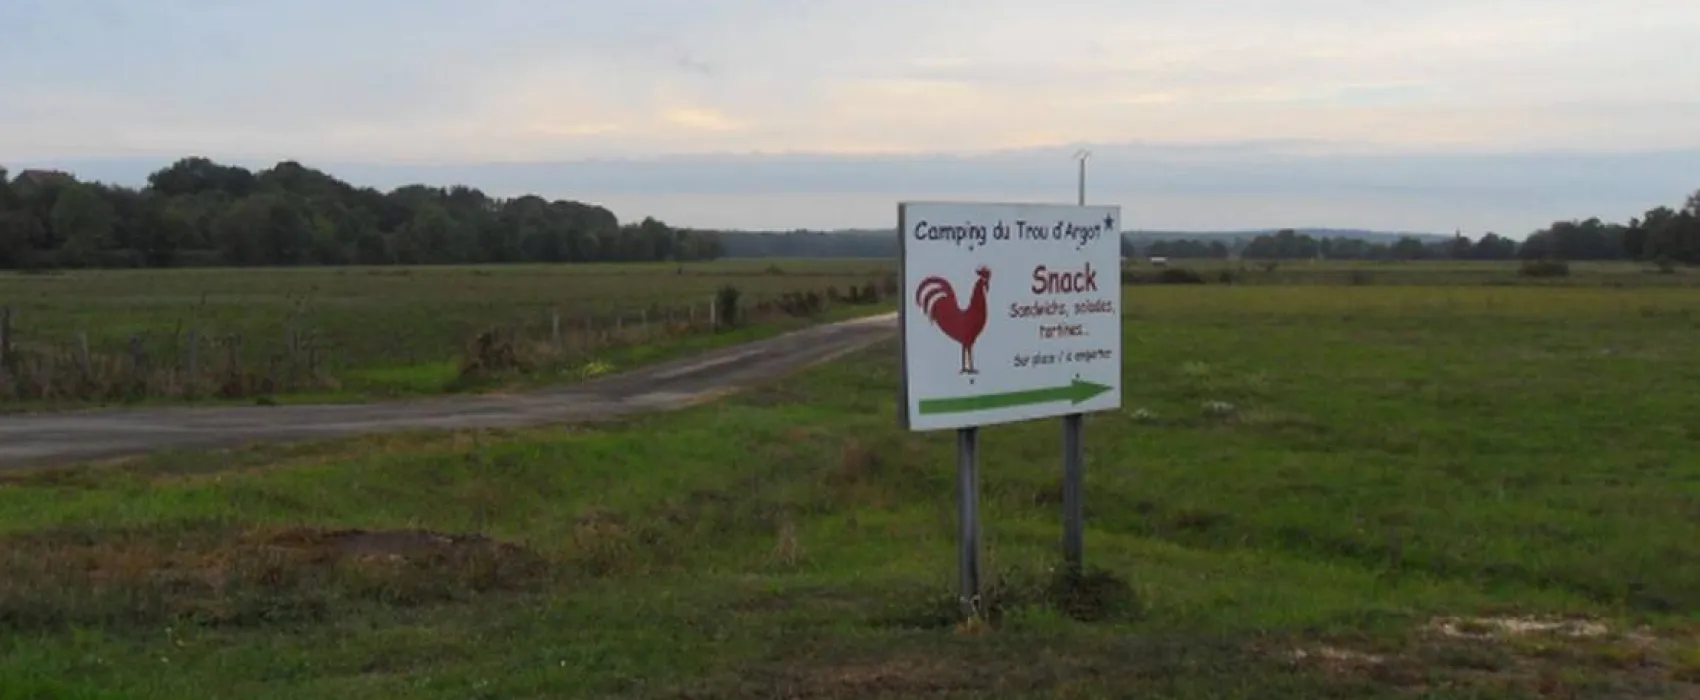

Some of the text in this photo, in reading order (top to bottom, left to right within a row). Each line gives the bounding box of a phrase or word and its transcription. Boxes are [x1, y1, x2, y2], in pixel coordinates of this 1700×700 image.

[914, 220, 987, 245] Camping
[993, 220, 1010, 240] du
[1016, 220, 1048, 240] Trou
[1032, 261, 1098, 294] Snack
[1014, 353, 1030, 367] Sur
